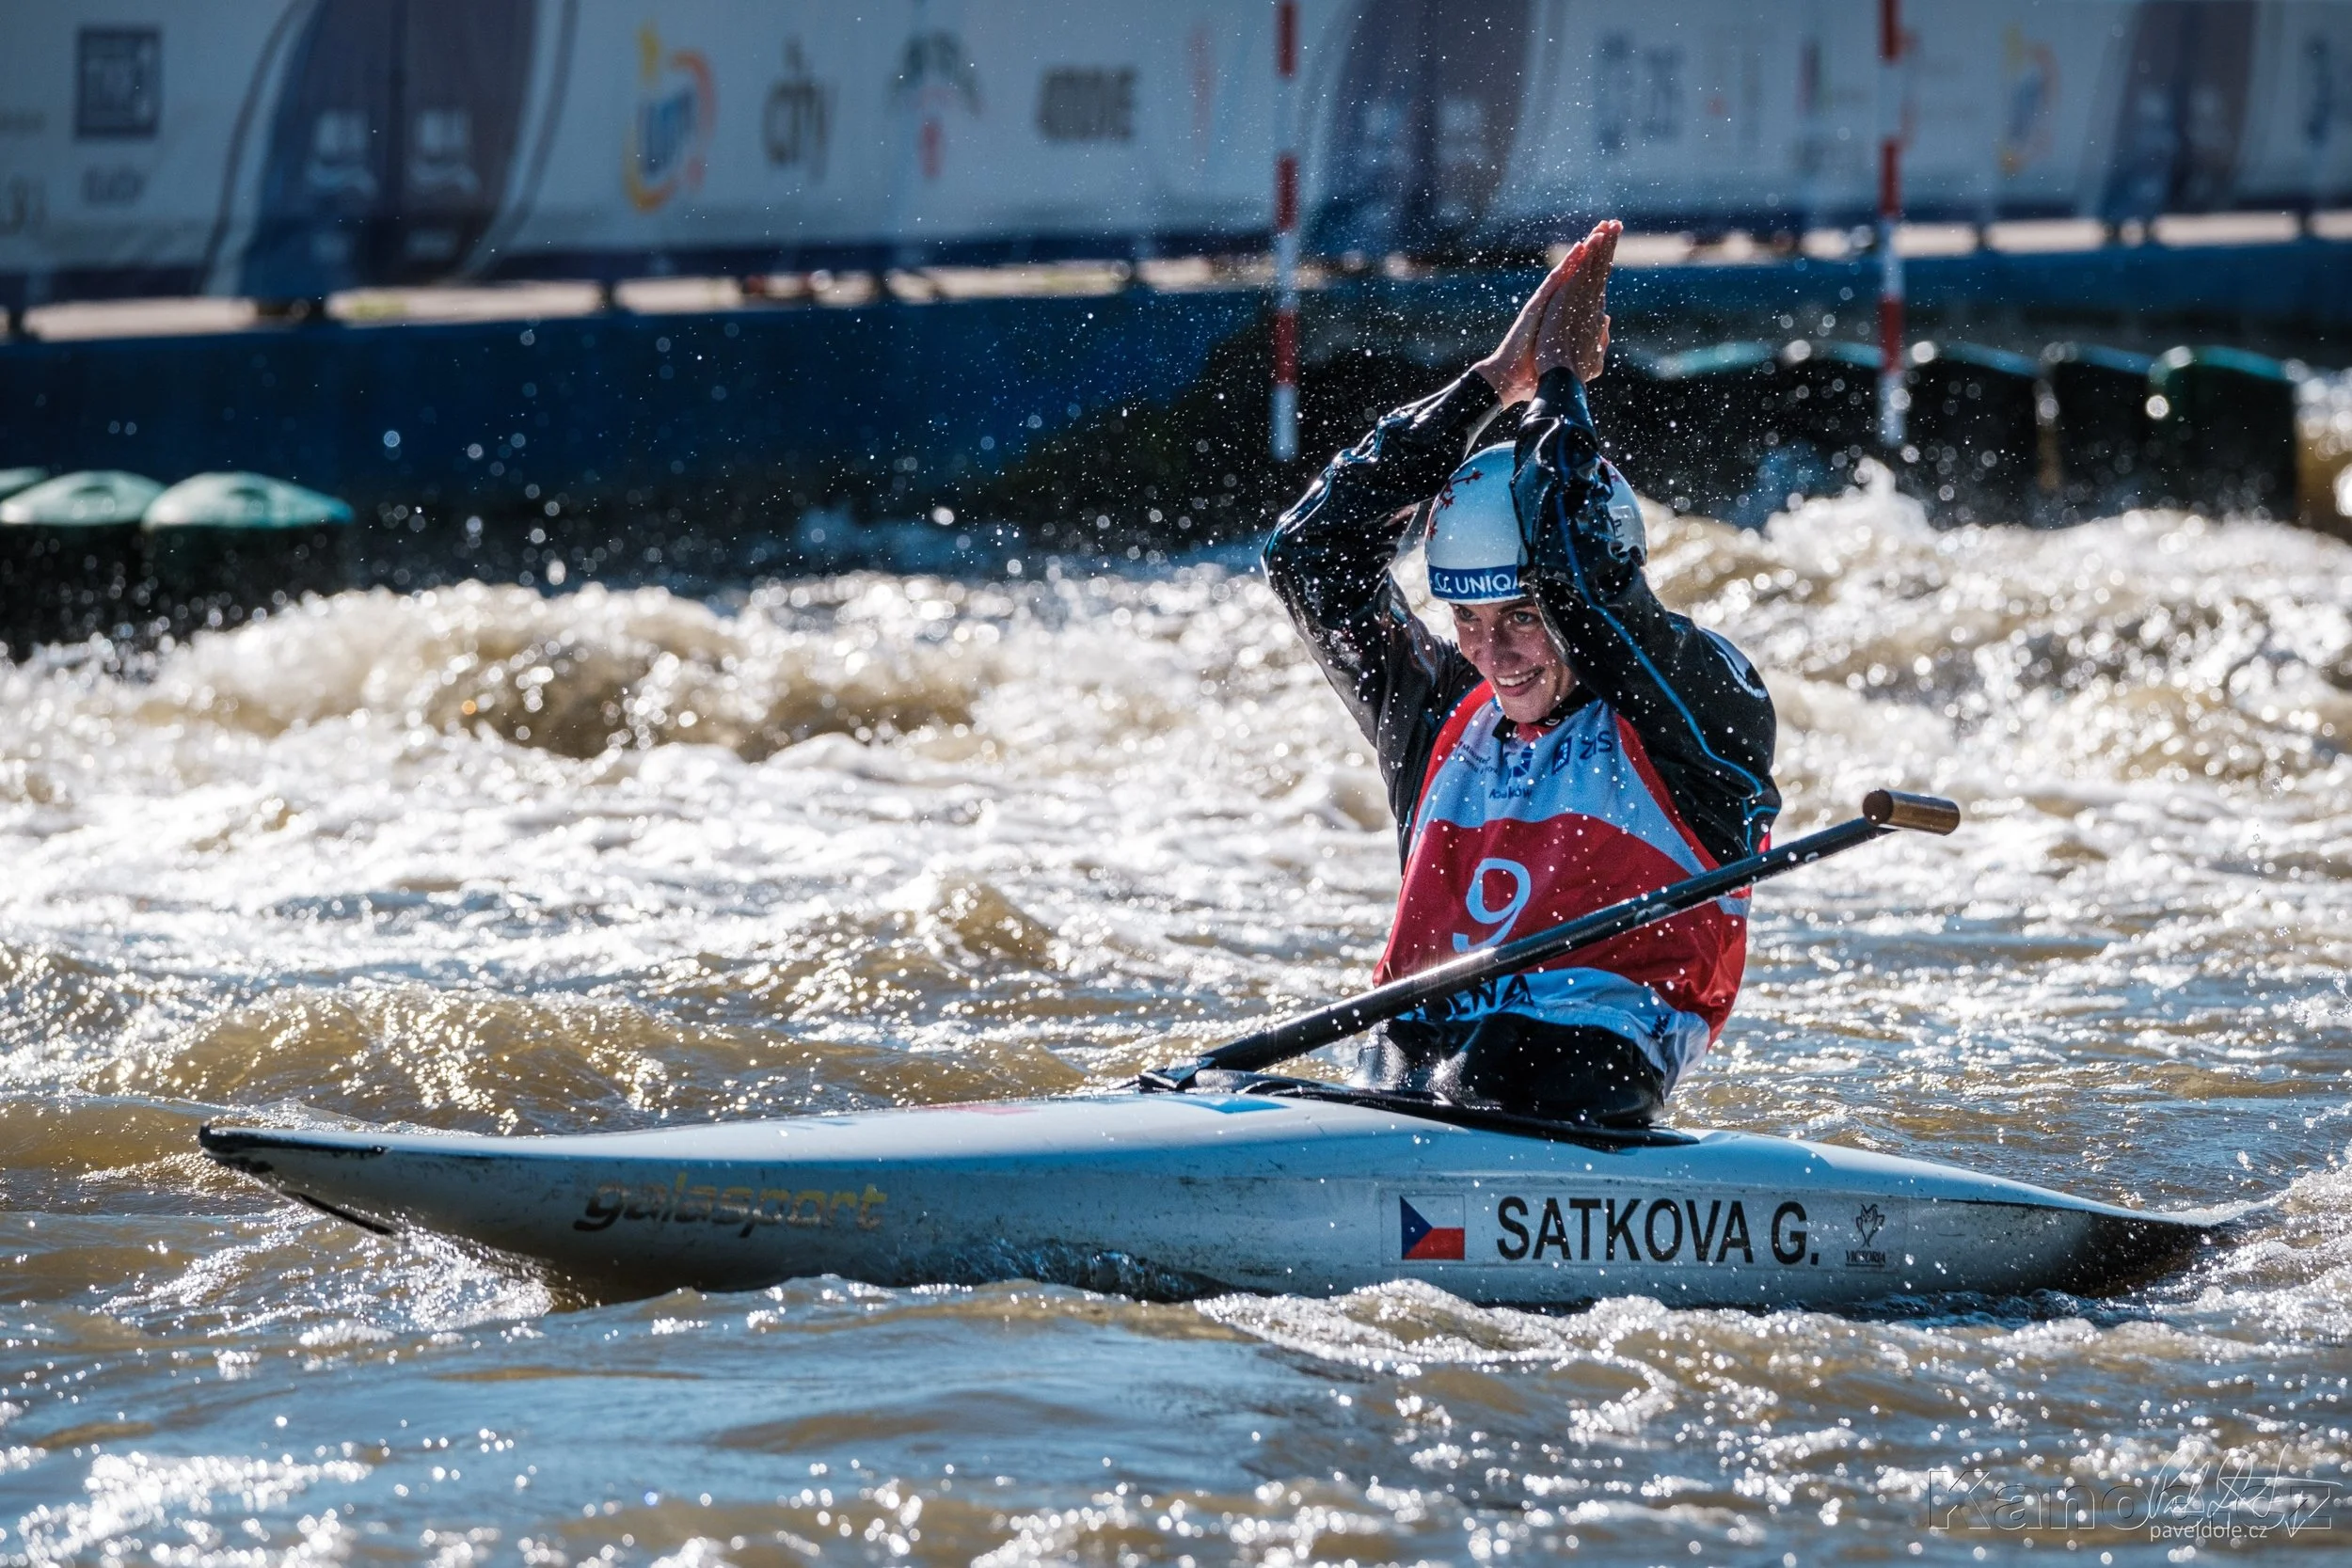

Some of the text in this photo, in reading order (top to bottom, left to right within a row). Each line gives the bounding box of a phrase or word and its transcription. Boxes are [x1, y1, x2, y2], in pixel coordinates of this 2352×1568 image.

[1452, 857, 1532, 954] 9
[573, 1172, 888, 1238] galasport
[1496, 1196, 1820, 1266] SATKOVA G.
[1845, 1249, 1886, 1264] VICTORIA
